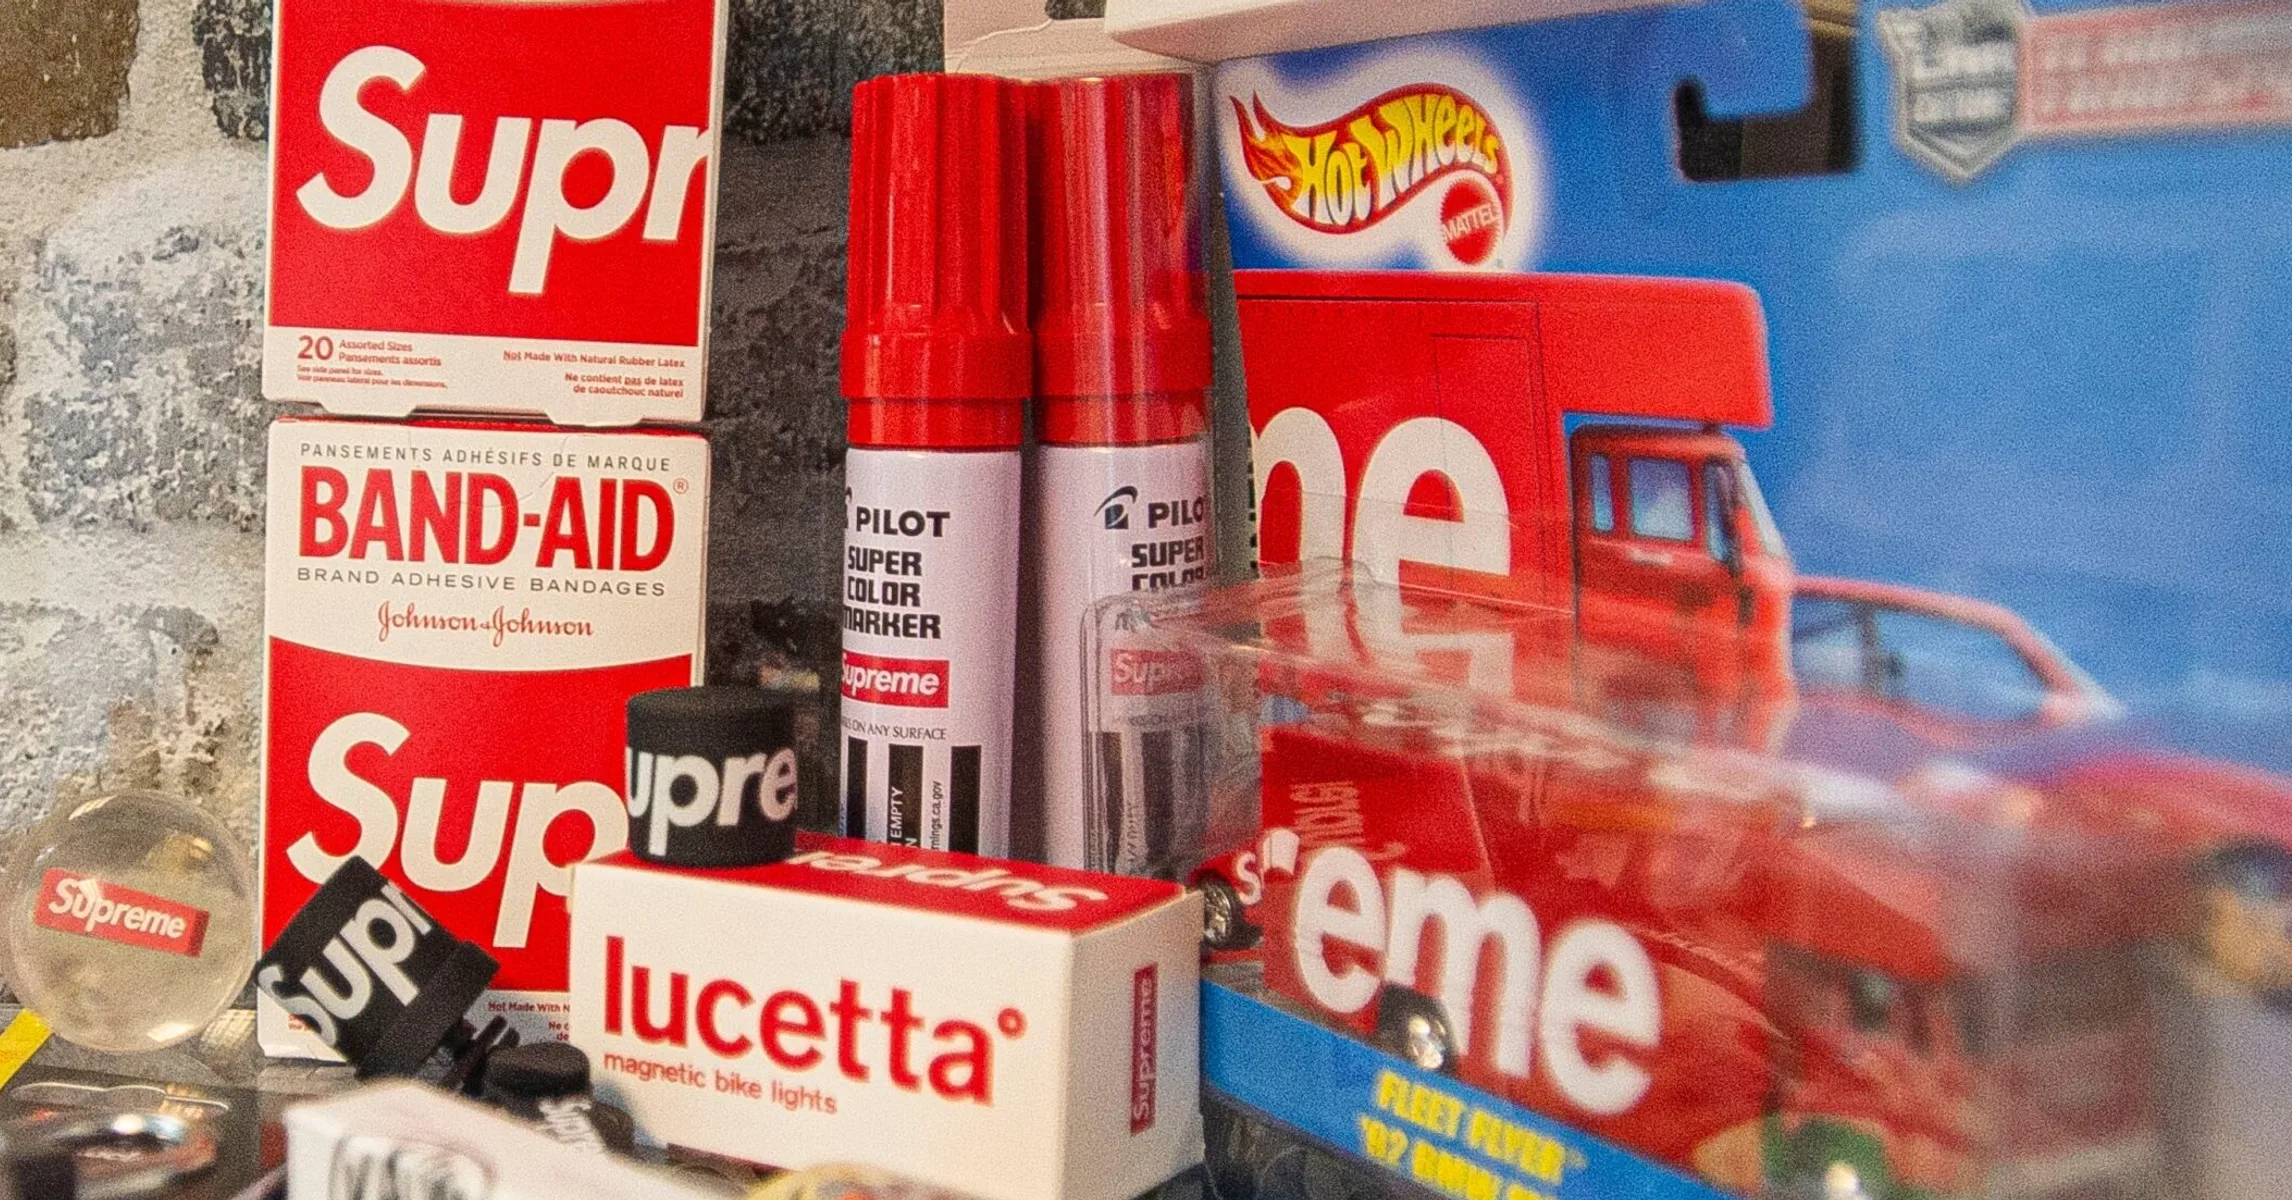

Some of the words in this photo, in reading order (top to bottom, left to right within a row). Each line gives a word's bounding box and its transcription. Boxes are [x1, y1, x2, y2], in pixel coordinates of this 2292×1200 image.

[1444, 203, 1502, 240] MATTEL
[297, 335, 333, 360] 20
[339, 339, 385, 351] Assorted
[386, 341, 413, 352] Sizes
[339, 352, 400, 365] Pansements
[402, 356, 442, 367] assortis
[503, 350, 521, 361] Not
[524, 351, 551, 361] Made
[553, 352, 577, 363] With
[580, 353, 616, 364] Natural
[619, 356, 655, 366] Rubber
[658, 357, 685, 367] Latex
[565, 372, 579, 382] Ne
[580, 374, 622, 385] contient
[624, 376, 641, 387] pas
[644, 376, 657, 386] de
[659, 377, 684, 387] latex
[573, 385, 585, 393] de
[588, 386, 645, 396] caoutchouc
[648, 388, 684, 398] naturel
[300, 443, 432, 462] PANSEMENTS
[442, 448, 542, 466] ADHÉSIFS
[553, 454, 576, 468] DE
[586, 455, 671, 473] MARQUE
[856, 505, 951, 538] PILOT
[848, 545, 922, 577] SUPER
[297, 567, 379, 585] BRAND
[391, 572, 516, 592] ADHESIVE
[530, 578, 666, 597] BANDAGES
[848, 576, 921, 608] COLOR
[378, 600, 477, 642] Johnson
[492, 605, 593, 648] Johnson
[844, 605, 941, 640] MARKER
[842, 652, 940, 697] upreme
[867, 723, 890, 737] ANY
[892, 725, 947, 740] SURFACE
[890, 787, 903, 838] EMPTY
[49, 878, 187, 938] Supreme
[488, 1002, 506, 1012] Not
[509, 1002, 535, 1011] Made
[537, 1003, 560, 1012] With
[549, 1021, 562, 1030] Ne
[1133, 978, 1156, 1120] Supreme
[604, 1053, 707, 1089] magnetic
[715, 1069, 762, 1099] bike
[771, 1080, 838, 1114] lights
[1377, 1069, 1464, 1139] FLEET
[1469, 1109, 1566, 1185] FLYER
